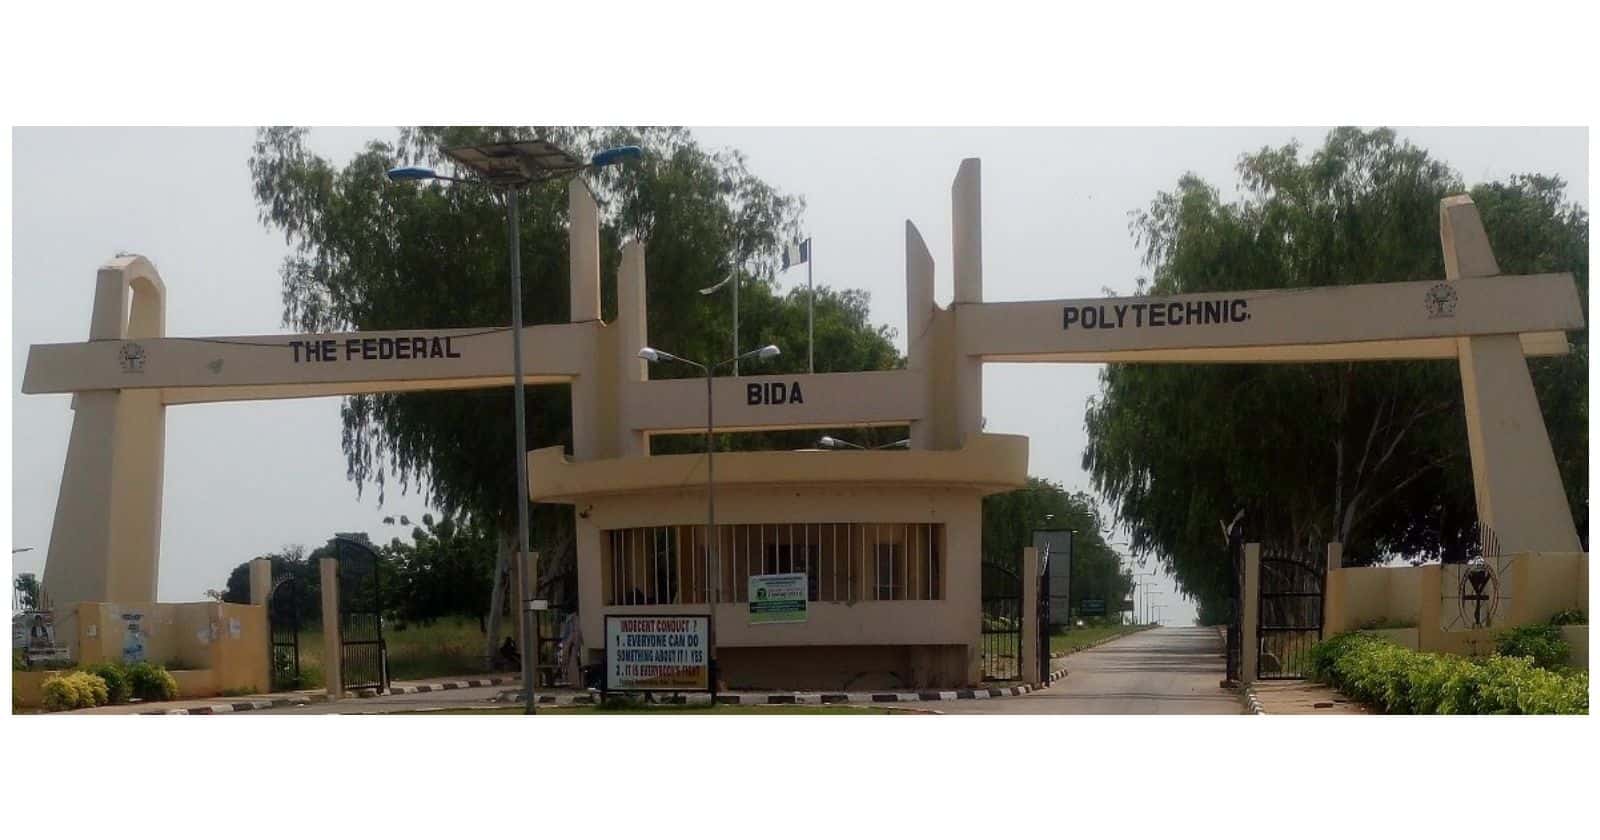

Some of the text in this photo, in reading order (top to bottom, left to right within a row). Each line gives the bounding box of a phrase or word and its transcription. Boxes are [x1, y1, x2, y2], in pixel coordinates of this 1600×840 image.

[289, 336, 461, 363] THE FEDERAL
[747, 381, 803, 405] BIDA
[620, 619, 655, 632] INDECENT
[656, 619, 689, 632] CONDUCT
[627, 634, 666, 647] EVERYONE
[668, 634, 685, 647] CAN
[687, 634, 699, 647] DO
[616, 649, 653, 662] SOMETHING
[655, 649, 676, 662] ABOUT
[691, 650, 703, 663] YES
